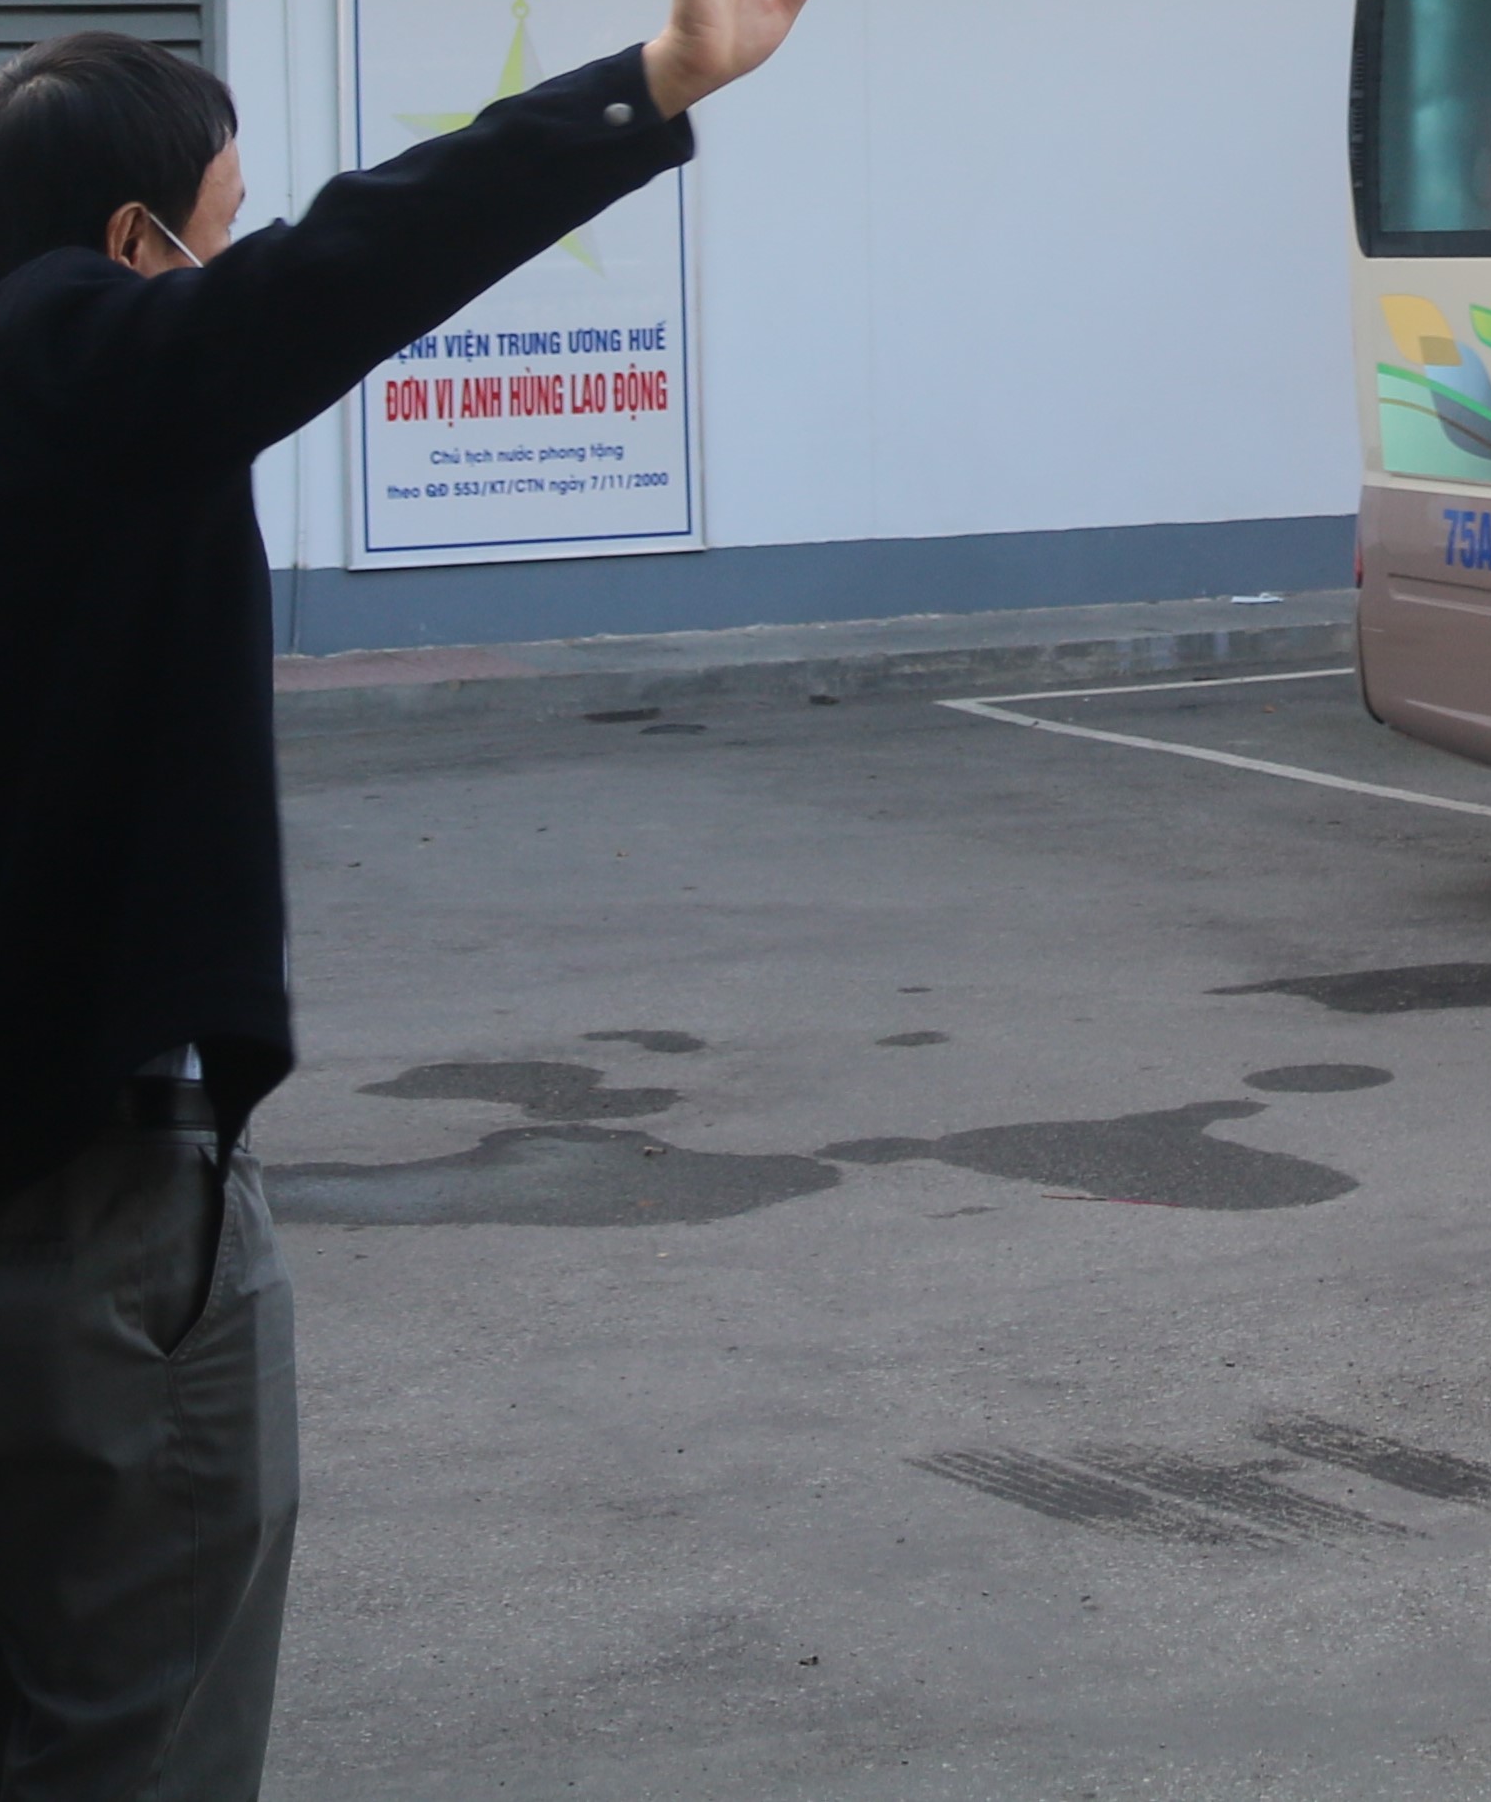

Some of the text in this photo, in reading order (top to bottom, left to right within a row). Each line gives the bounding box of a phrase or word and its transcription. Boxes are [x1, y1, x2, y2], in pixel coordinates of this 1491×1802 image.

[397, 320, 666, 364] NH VIỆN TRUNG ƯƠNG HUẾ
[386, 363, 668, 427] ĐƠN VỊ ANH HÙNG LAO ĐỘNG
[430, 448, 461, 465] Chủ
[539, 446, 586, 463] phong
[387, 485, 421, 499] theo
[453, 478, 545, 497] 553/KT/CTN
[549, 475, 586, 496] ngày
[590, 472, 669, 491] 7/11/2000
